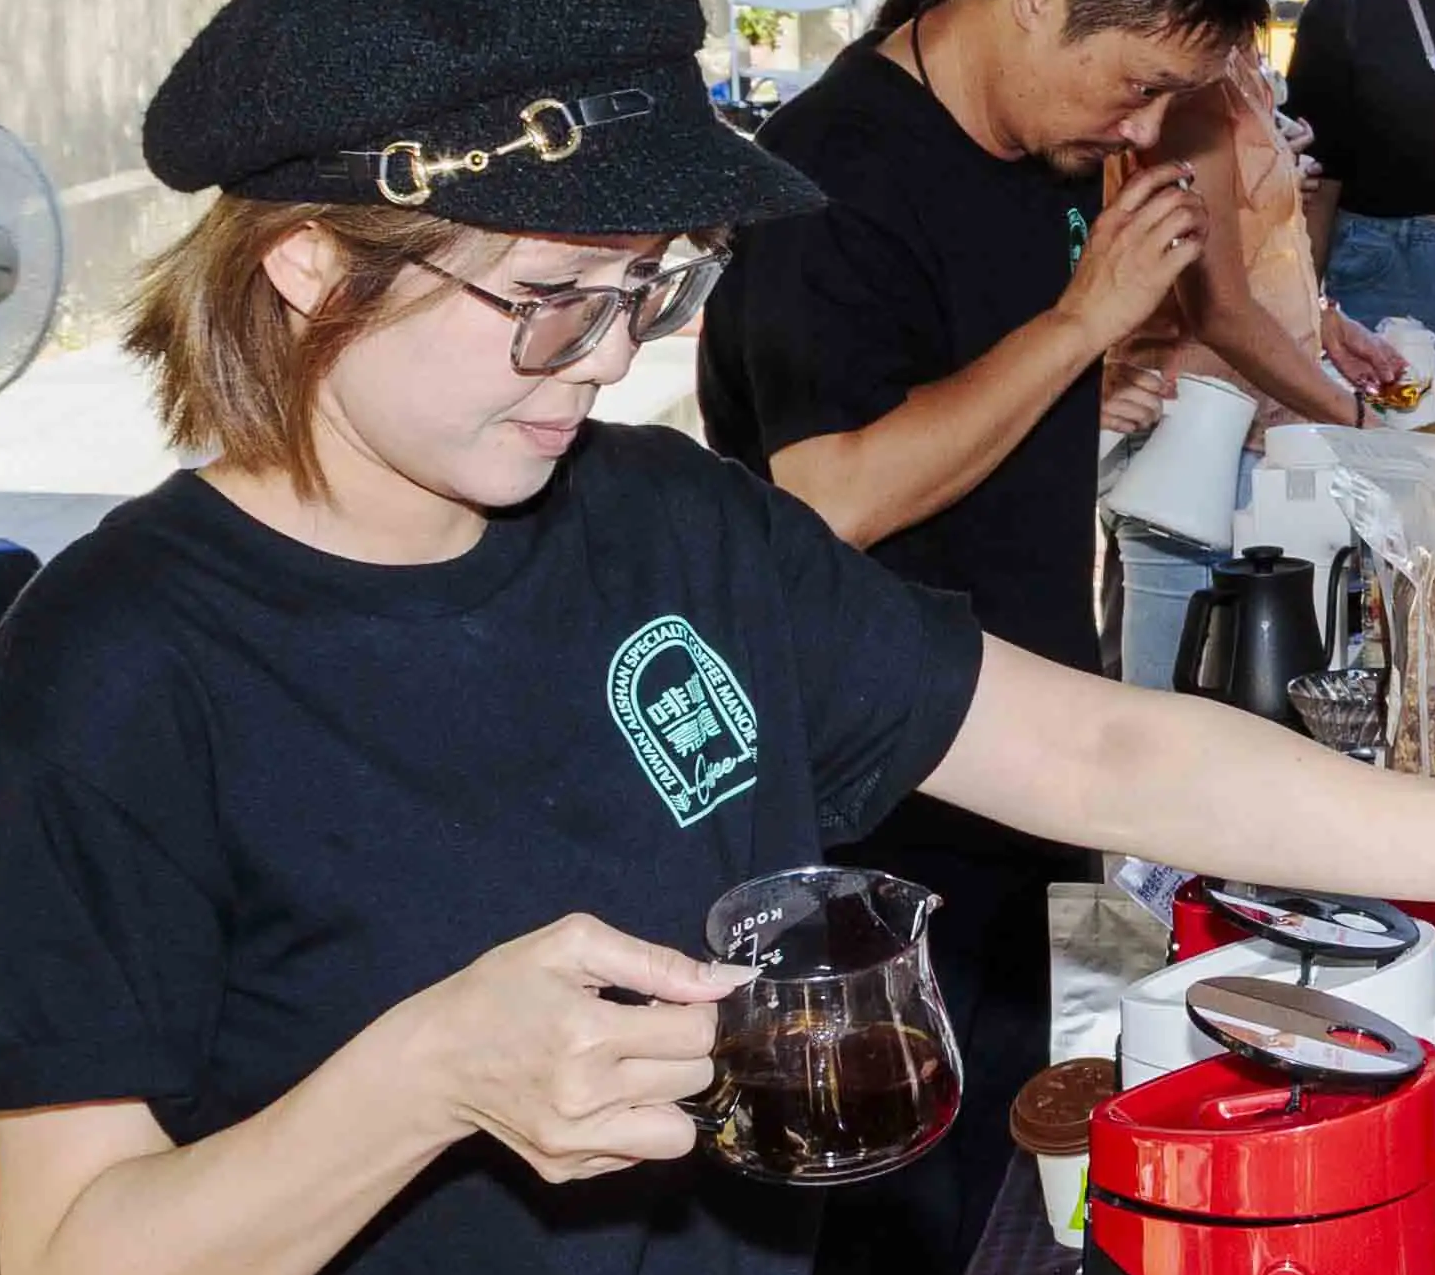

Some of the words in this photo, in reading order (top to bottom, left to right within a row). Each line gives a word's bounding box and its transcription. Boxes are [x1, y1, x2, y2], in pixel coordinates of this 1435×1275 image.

[623, 623, 689, 668] SPECIALTY
[687, 636, 725, 686] COFFEE
[615, 664, 641, 732] ALISHAN
[716, 685, 757, 744] MANOR
[634, 730, 678, 791] TAIWAN
